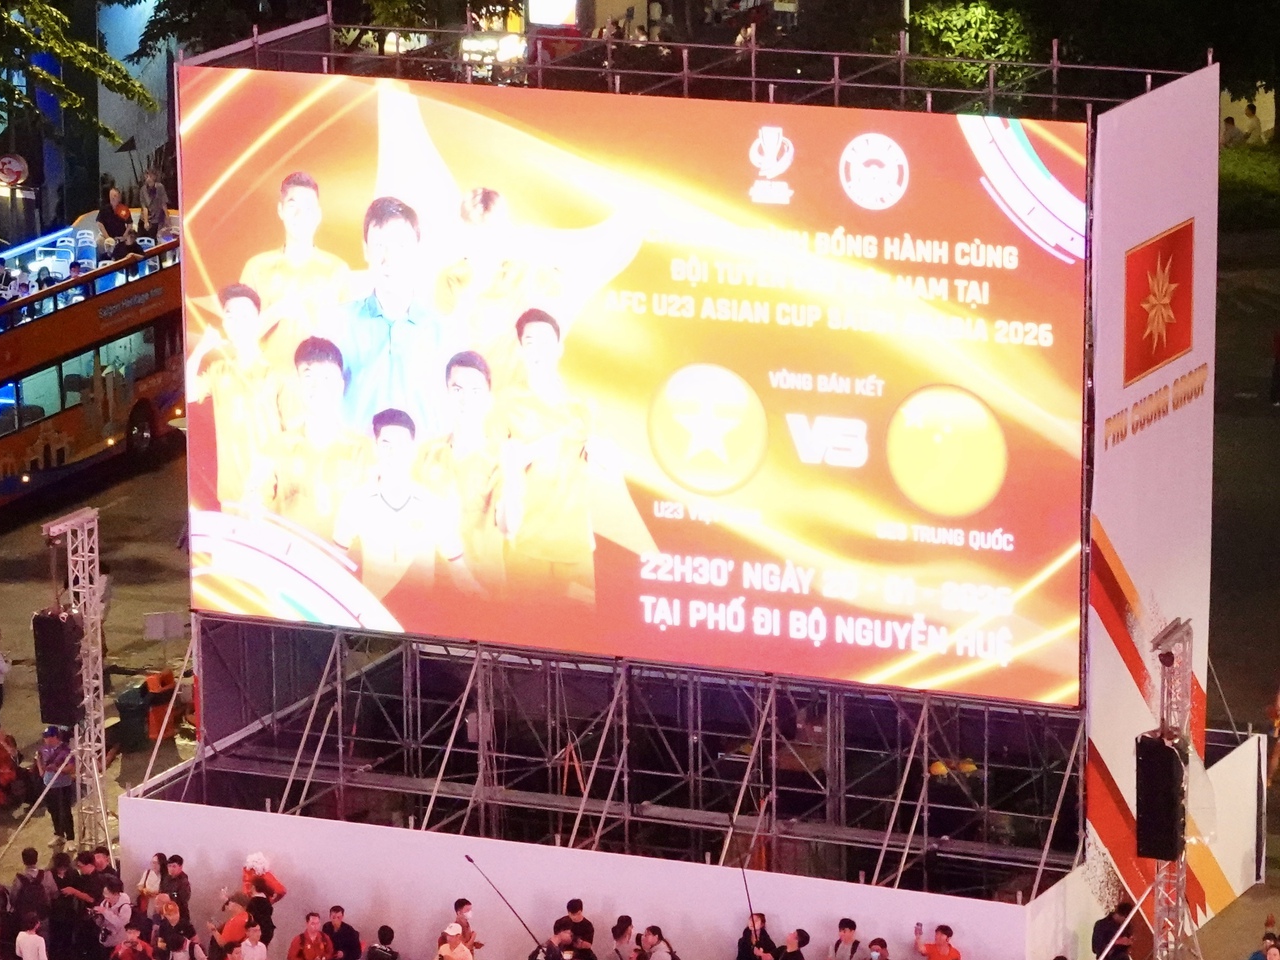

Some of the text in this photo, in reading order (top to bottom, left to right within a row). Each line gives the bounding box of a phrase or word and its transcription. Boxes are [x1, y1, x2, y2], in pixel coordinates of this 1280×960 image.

[883, 233, 949, 265] HÀNH
[954, 238, 1019, 270] CÙNG
[670, 254, 708, 288] ĐỘI
[897, 275, 949, 302] NAM
[954, 279, 990, 309] TẠI
[604, 290, 646, 314] AFC
[652, 293, 695, 319] U23
[700, 297, 770, 325] ASIAN
[776, 302, 821, 328] CUP
[994, 319, 1054, 347] 2026
[769, 368, 886, 398] VÒNG BÁN KẾT
[1104, 407, 1128, 452] PHU
[1172, 362, 1209, 412] GROUP
[785, 412, 869, 468] VS
[653, 500, 684, 519] U23
[911, 524, 964, 547] TRUNG
[969, 527, 1015, 552] QUỐC
[742, 558, 815, 595] NGÀY
[640, 596, 1015, 667] TẠI PHỐ ĐI BỘ NGUYỄN HUỆ
